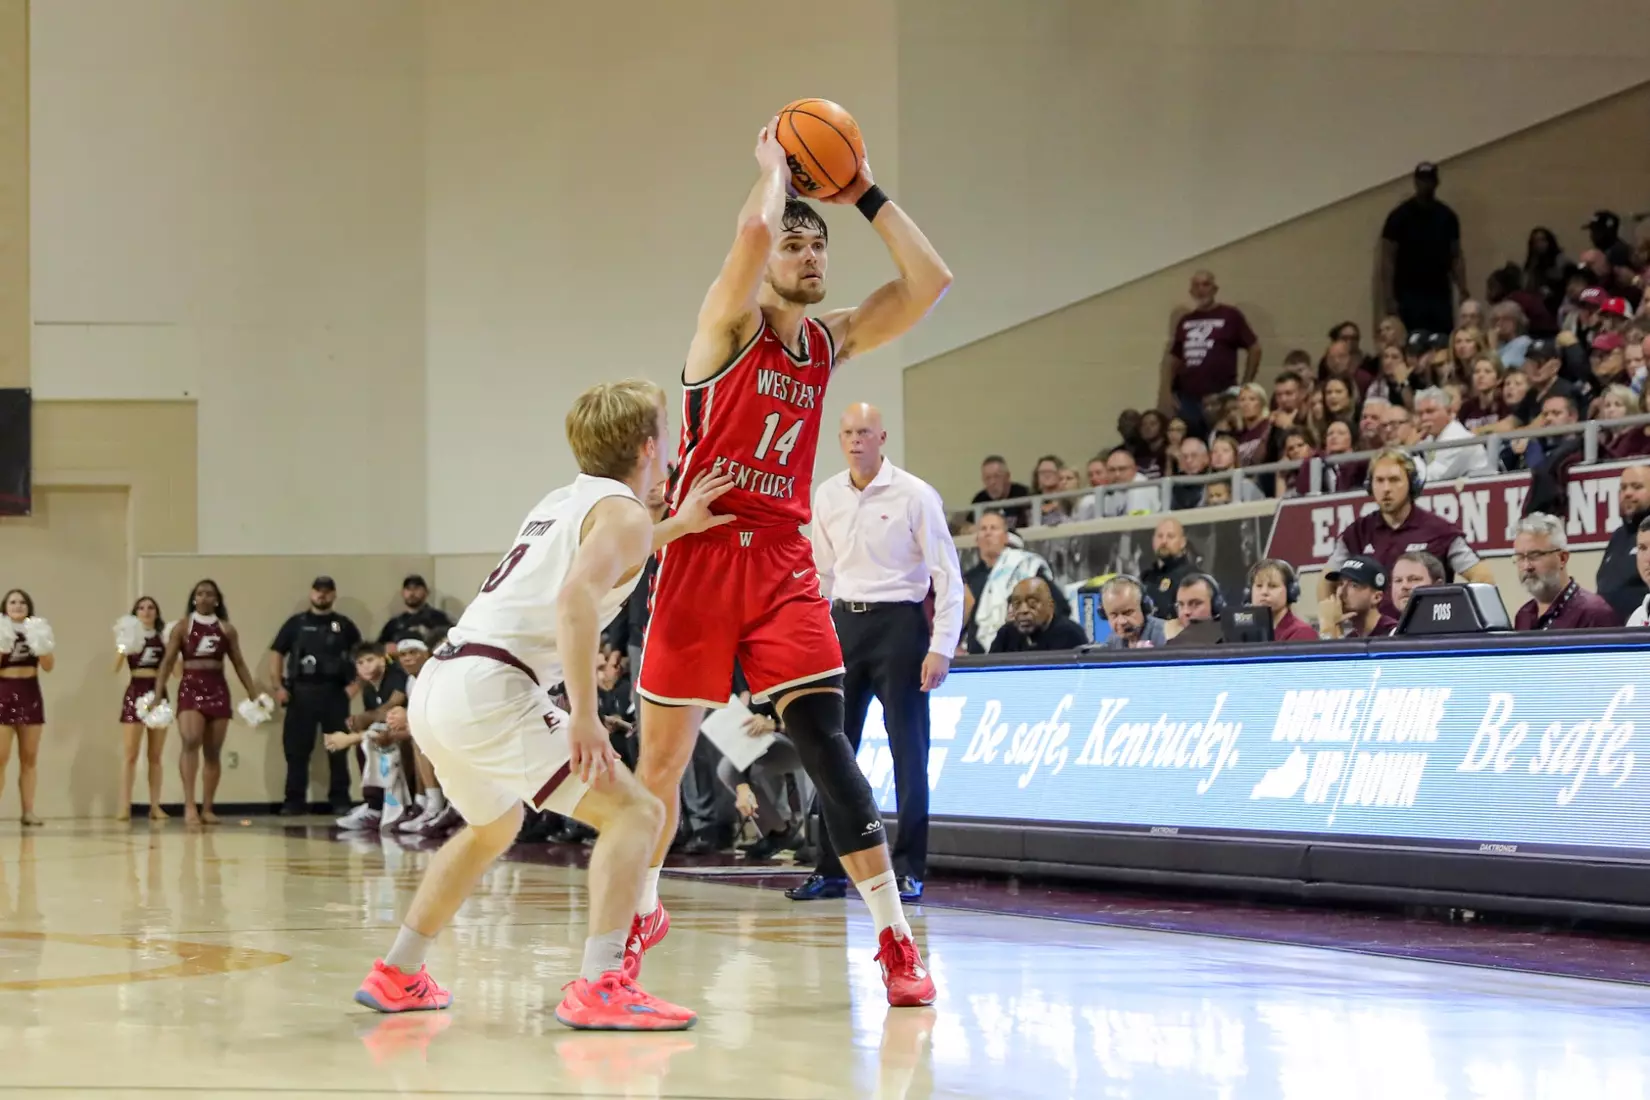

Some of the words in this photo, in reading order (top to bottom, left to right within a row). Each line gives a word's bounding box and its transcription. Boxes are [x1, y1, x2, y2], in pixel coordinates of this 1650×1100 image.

[757, 368, 821, 409] WESTER
[753, 411, 804, 466] 14
[739, 531, 754, 547] W
[481, 543, 530, 593] 0
[1432, 603, 1451, 620] POSS
[138, 646, 163, 666] E
[195, 635, 221, 656] E
[1271, 689, 1366, 742] BUCKLE
[1362, 687, 1452, 742] PHONE
[961, 700, 1008, 764] Be
[1004, 694, 1074, 790] safe,
[1075, 692, 1243, 795] Kentucky.
[1456, 692, 1530, 773] Be
[1529, 684, 1636, 806] safe,
[1303, 751, 1345, 804] UP
[1343, 751, 1428, 808] DOWN
